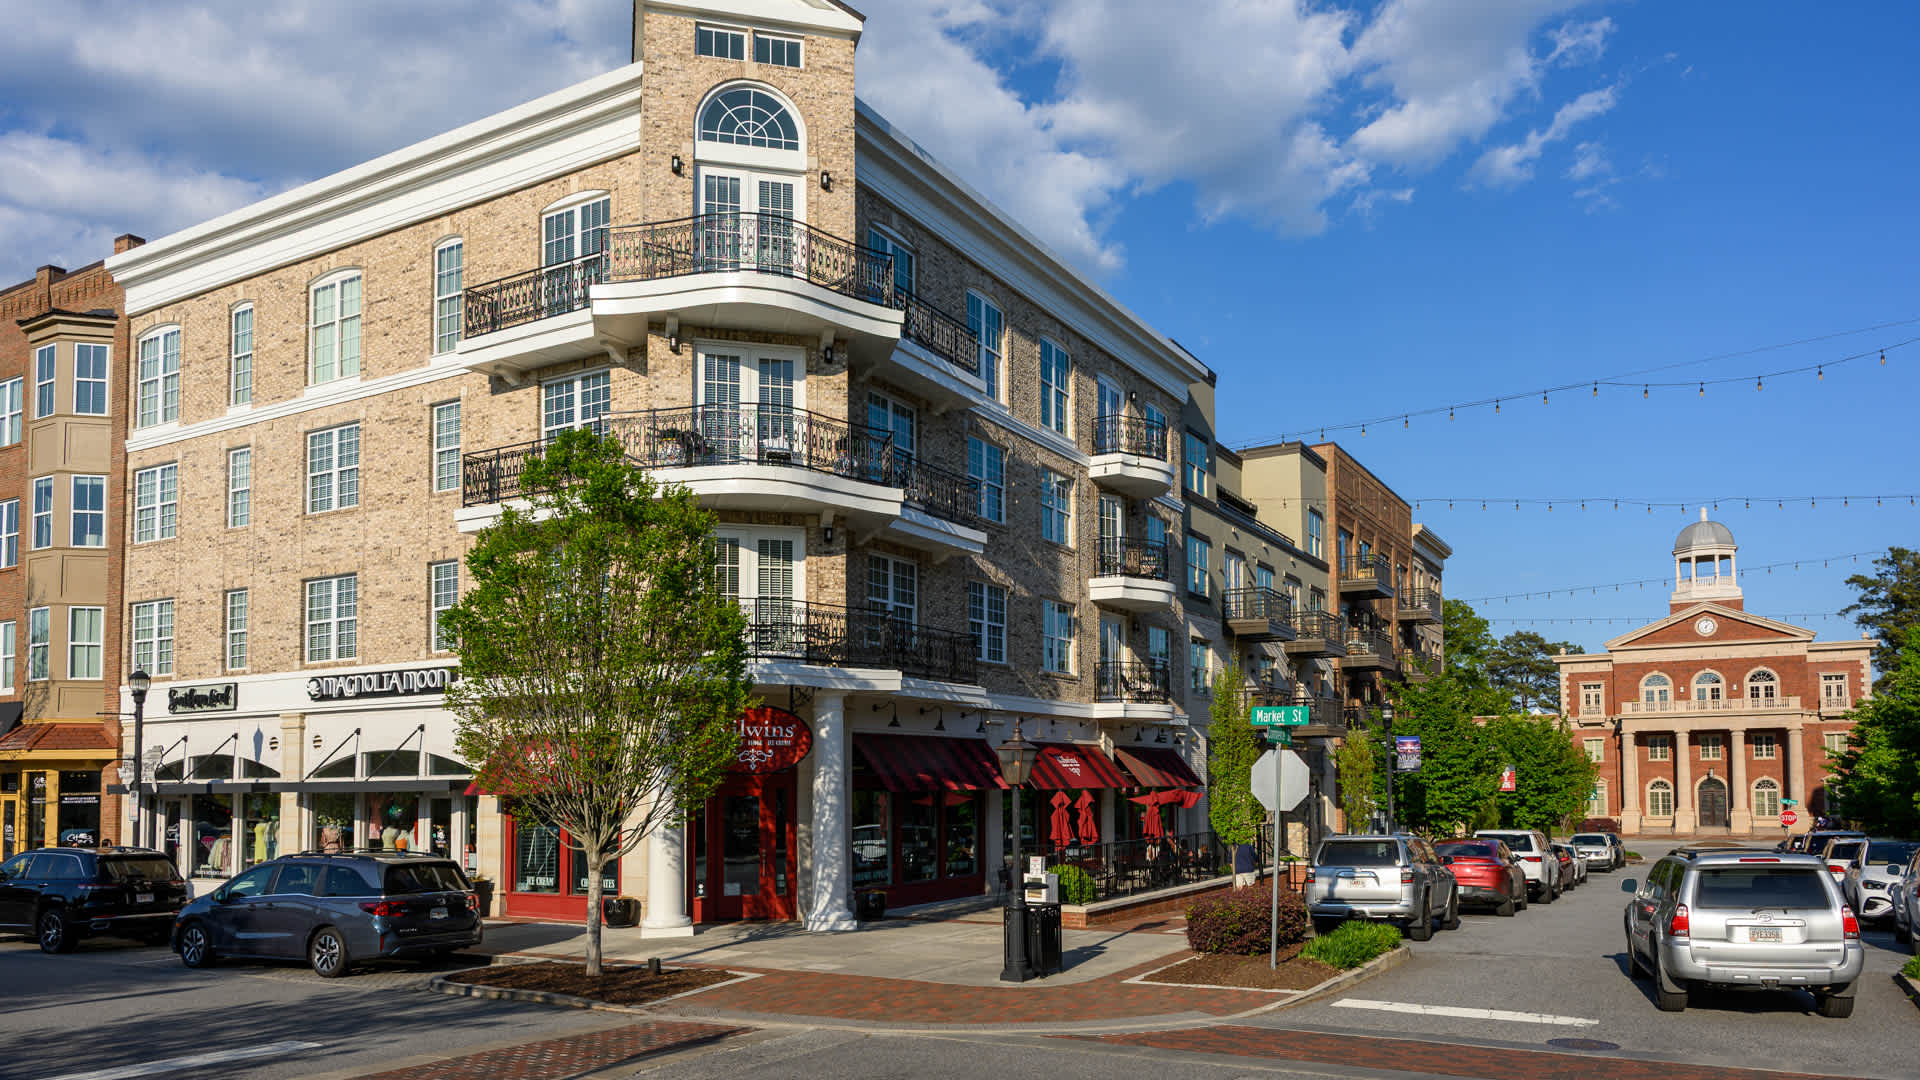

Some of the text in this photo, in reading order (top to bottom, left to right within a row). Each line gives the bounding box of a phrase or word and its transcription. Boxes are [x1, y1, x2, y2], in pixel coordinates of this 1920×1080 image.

[322, 669, 450, 698] MAGNOLIA MOON
[1256, 709, 1303, 723] Market St
[720, 719, 794, 738] ilwins
[526, 876, 554, 886] ICE CREAM
